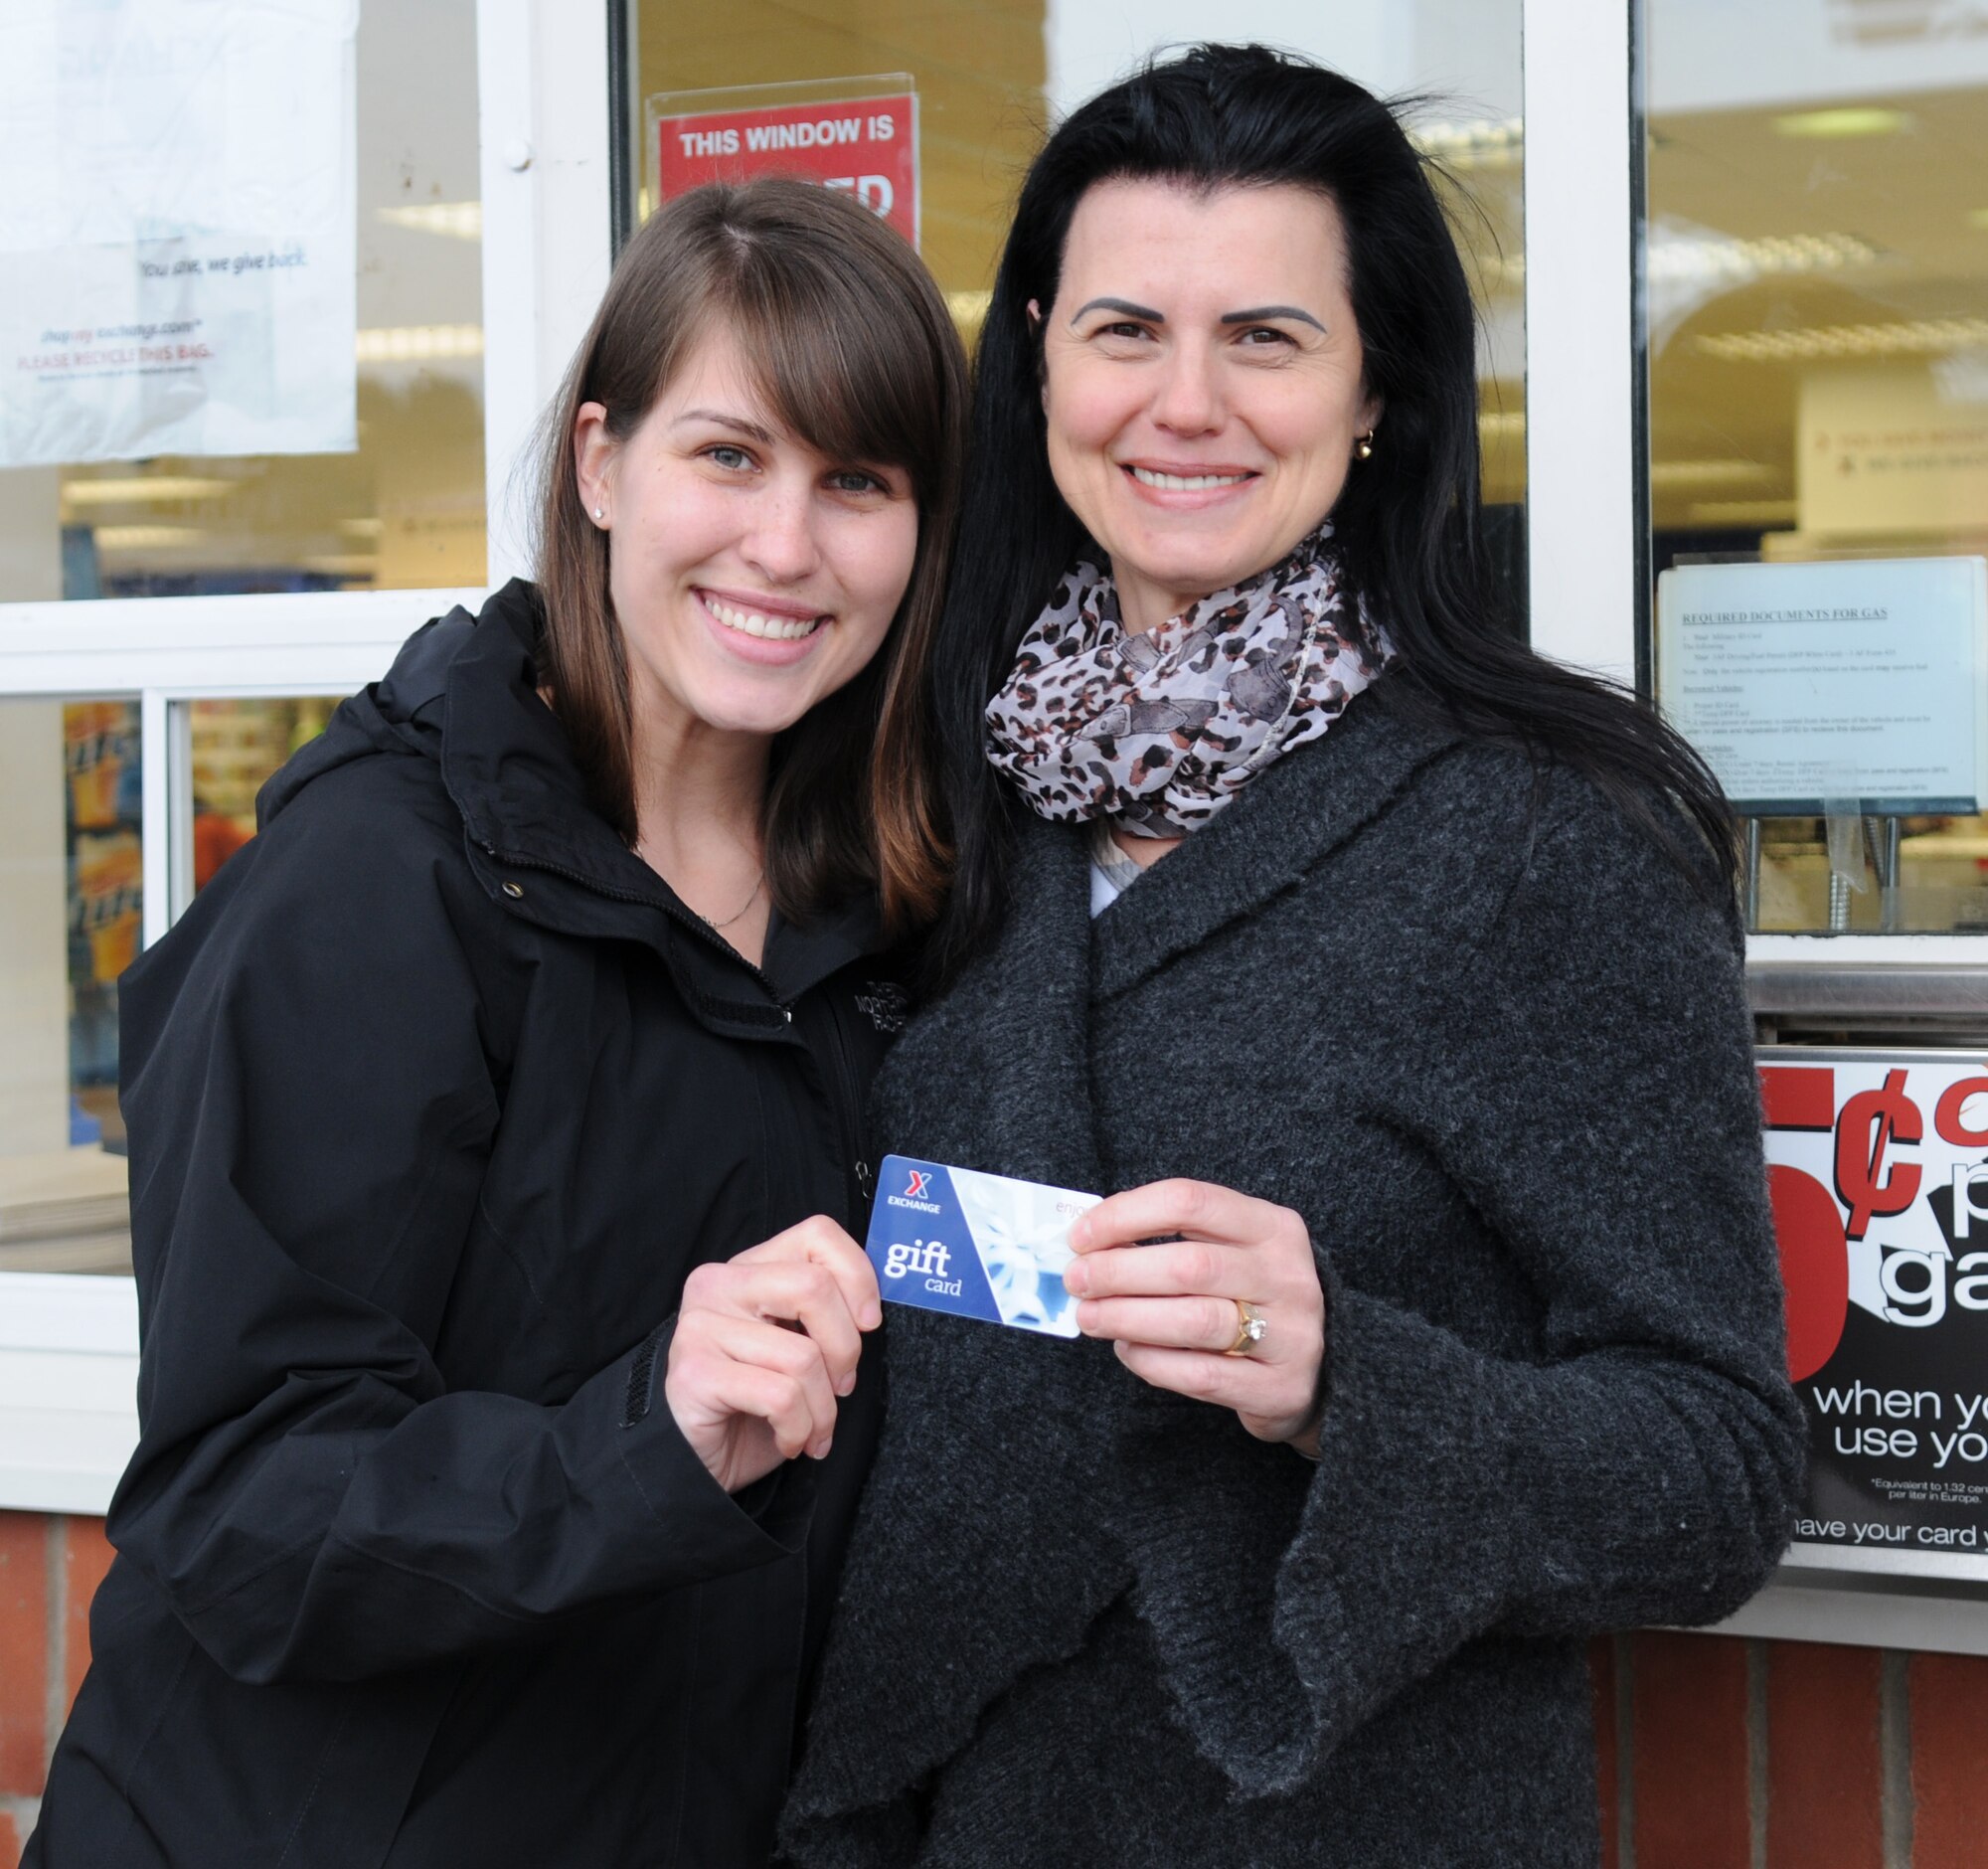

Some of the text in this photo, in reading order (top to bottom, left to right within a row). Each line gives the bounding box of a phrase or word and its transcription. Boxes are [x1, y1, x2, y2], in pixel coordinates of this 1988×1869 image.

[679, 114, 895, 157] THIS WINDOW IS
[138, 345, 172, 362] THIS
[1682, 606, 1889, 624] REQUIRED DOCUMENTS FOR GAS
[888, 1195, 942, 1215] EXCHANGE
[1056, 1202, 1087, 1220] enjo
[884, 1239, 951, 1278] gift
[924, 1277, 962, 1296] card
[1813, 1379, 1988, 1431] when y
[1835, 1426, 1918, 1458] use
[1930, 1481, 1942, 1491] to
[1944, 1482, 1966, 1493] 1.32
[1889, 1490, 1982, 1505] per liter in Europe.
[1853, 1522, 1911, 1544] your
[1917, 1525, 1977, 1547] card
